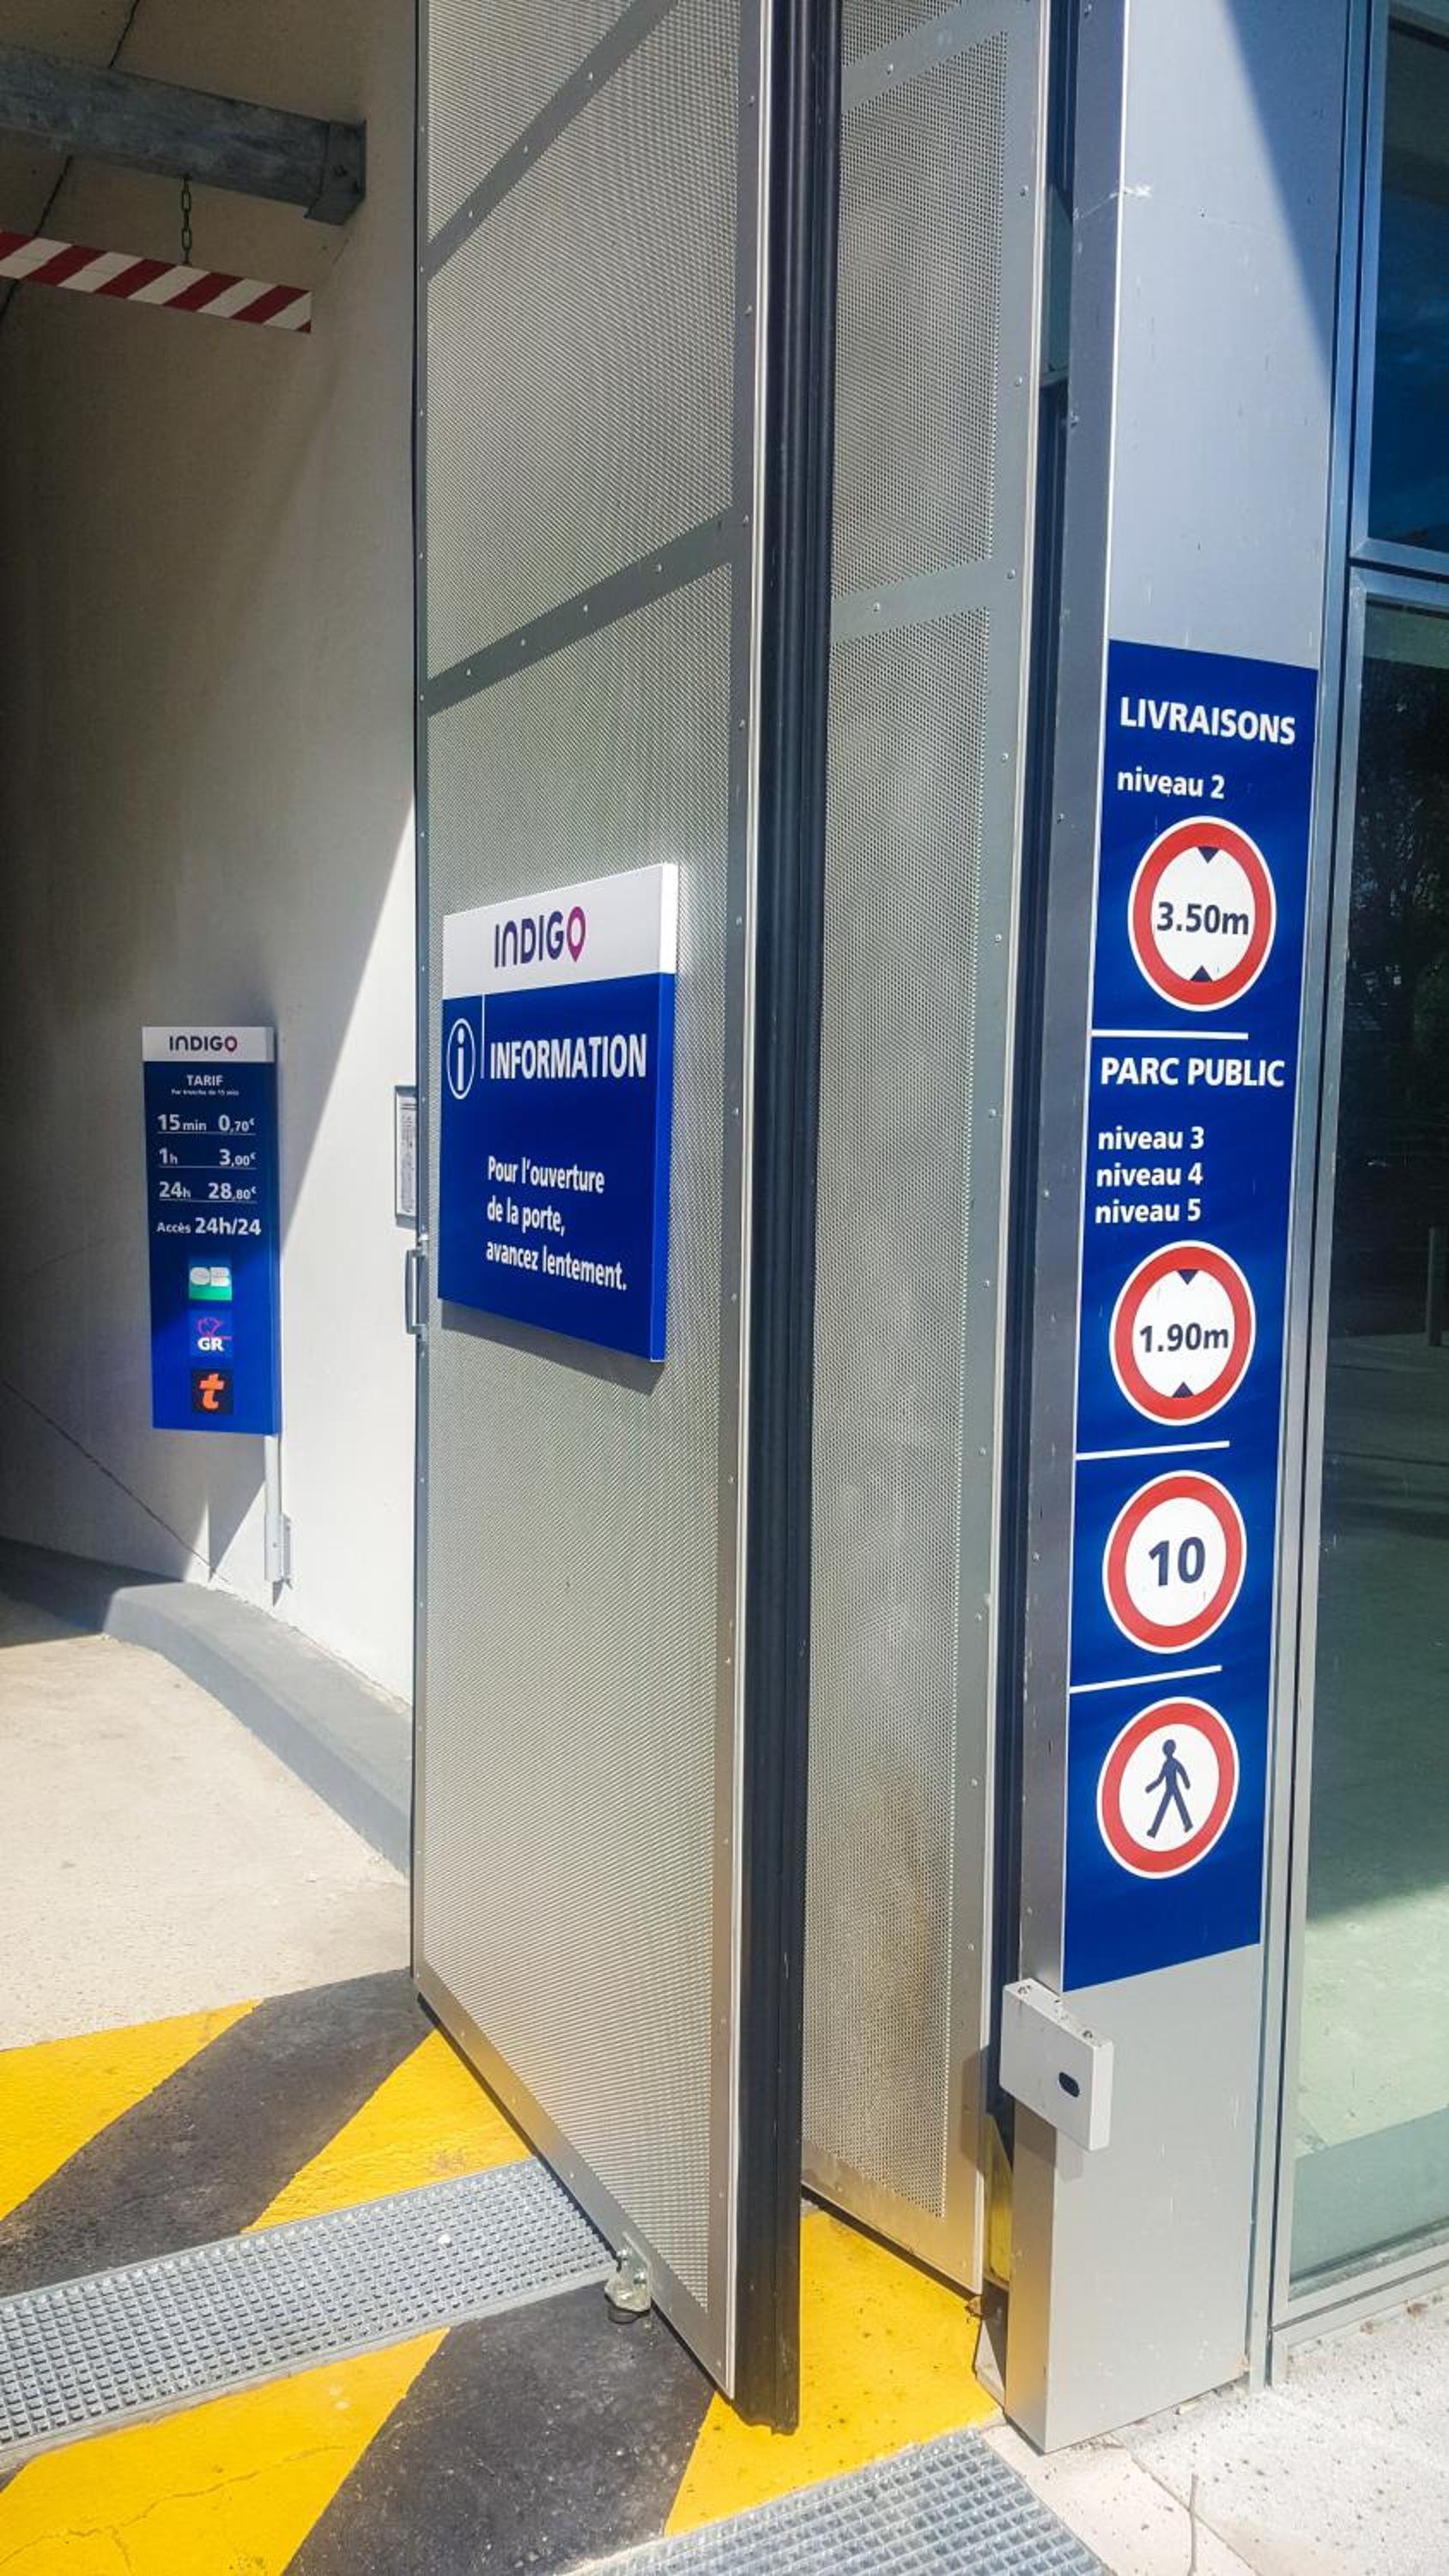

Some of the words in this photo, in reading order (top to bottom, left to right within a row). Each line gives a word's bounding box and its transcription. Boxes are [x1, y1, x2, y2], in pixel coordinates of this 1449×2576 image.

[1119, 697, 1296, 745] LIVRAISONS
[1117, 766, 1203, 798] niveau
[1210, 775, 1226, 799] 2
[1155, 900, 1250, 936] 3.50m
[494, 905, 586, 968] INDIGO
[169, 1036, 238, 1052] INDIGO
[489, 1033, 647, 1080] INFORMATION
[186, 1074, 224, 1086] TARIF
[1100, 1056, 1179, 1085] PARC
[1187, 1058, 1286, 1088] PUBLIC
[158, 1115, 179, 1130] 15
[183, 1119, 207, 1131] min
[1098, 1127, 1184, 1151] niveau
[1191, 1126, 1205, 1150] 3
[159, 1148, 178, 1164] 1h
[159, 1181, 191, 1199] 24h
[487, 1155, 518, 1184] Pour
[520, 1156, 605, 1194] l'ouverture
[1096, 1163, 1182, 1188] niveau
[1188, 1163, 1203, 1186] 4
[156, 1221, 191, 1234] Accès
[195, 1217, 262, 1236] 24h/24
[487, 1195, 504, 1224] de
[506, 1197, 519, 1225] la
[522, 1205, 566, 1235] porte,
[1094, 1200, 1180, 1224] niveau
[1187, 1198, 1202, 1221] 5
[486, 1240, 539, 1272] avancez
[542, 1247, 627, 1291] lentement.
[197, 1336, 226, 1352] GR
[1139, 1322, 1230, 1353] 1.90m
[1148, 1536, 1206, 1587] 10
